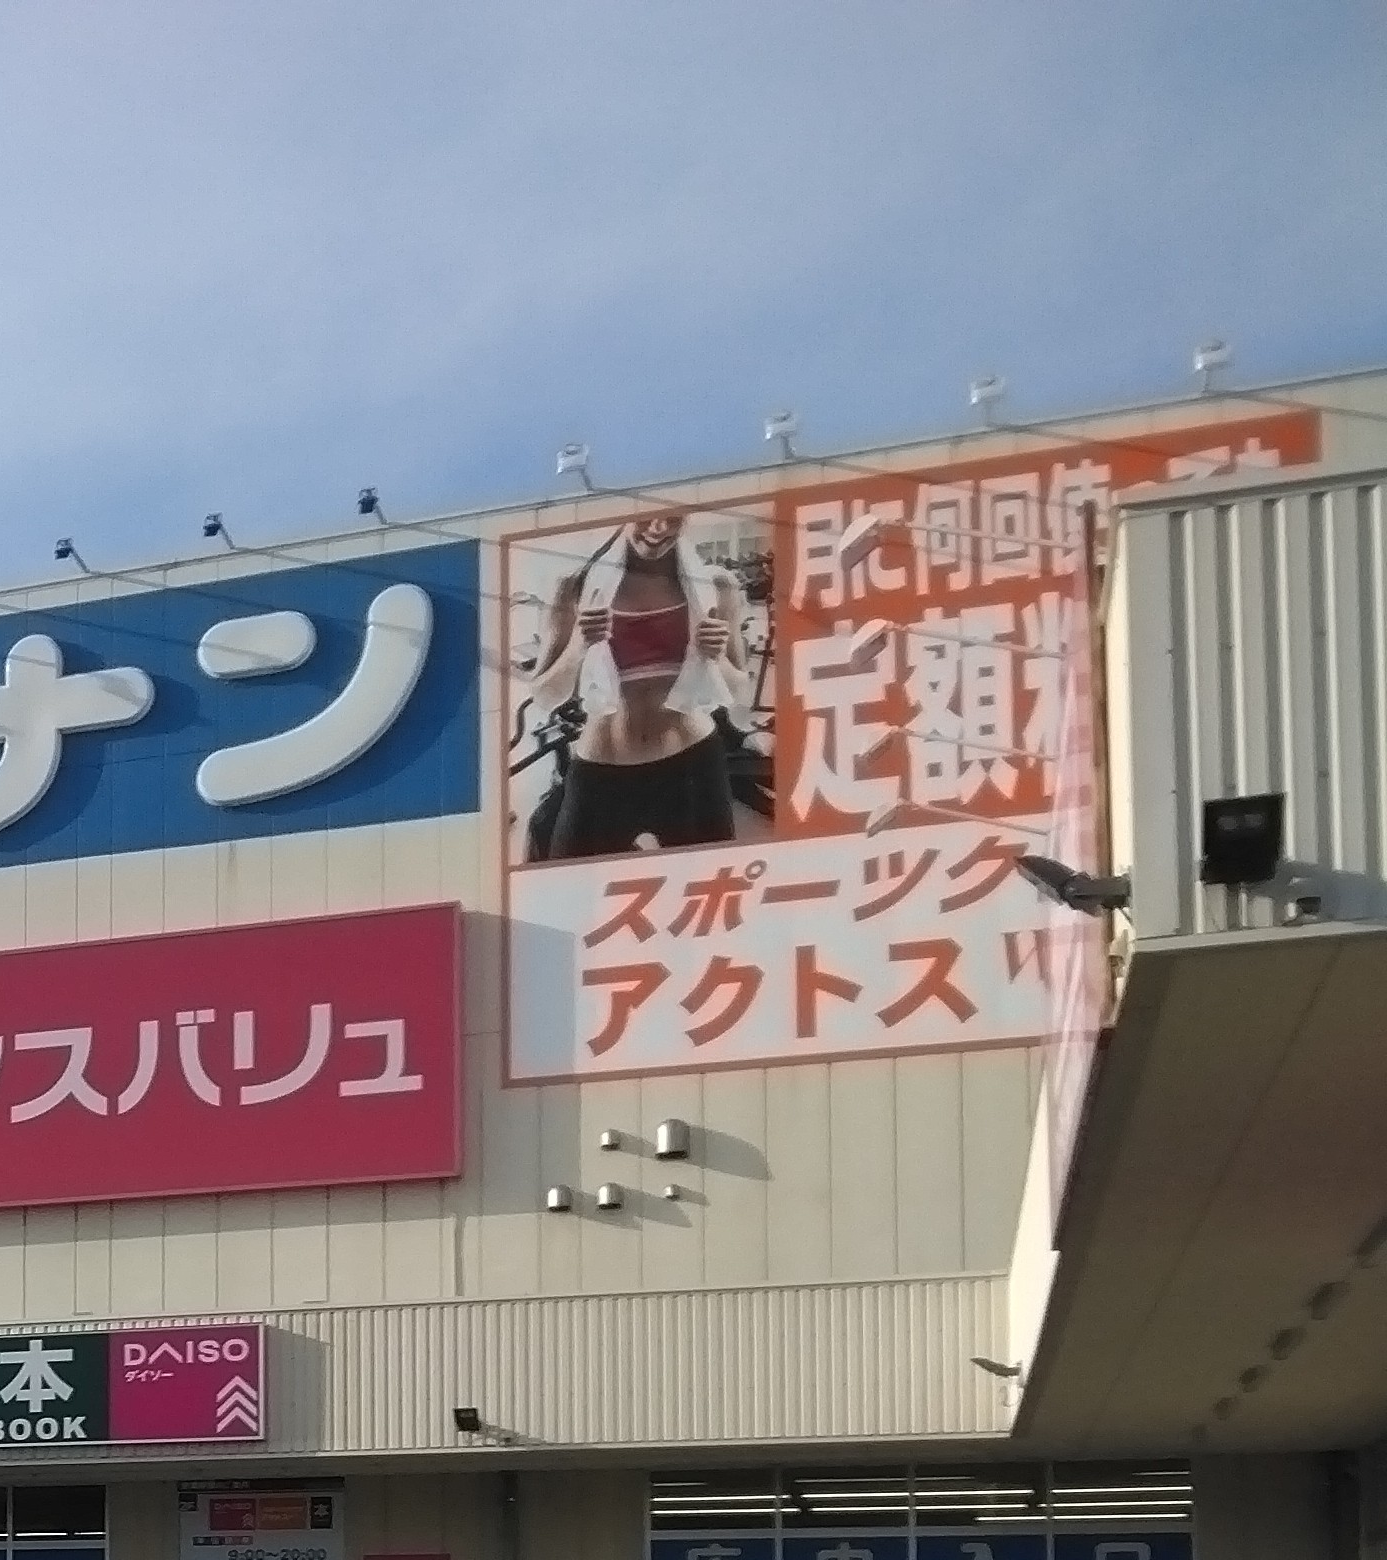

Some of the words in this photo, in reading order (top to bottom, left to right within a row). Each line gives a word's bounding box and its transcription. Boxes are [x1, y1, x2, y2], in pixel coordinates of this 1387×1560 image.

[583, 939, 978, 1057] アクトス
[0, 1339, 74, 1413] 本
[124, 1339, 250, 1367] DAISO
[124, 1369, 174, 1383] ダイソー
